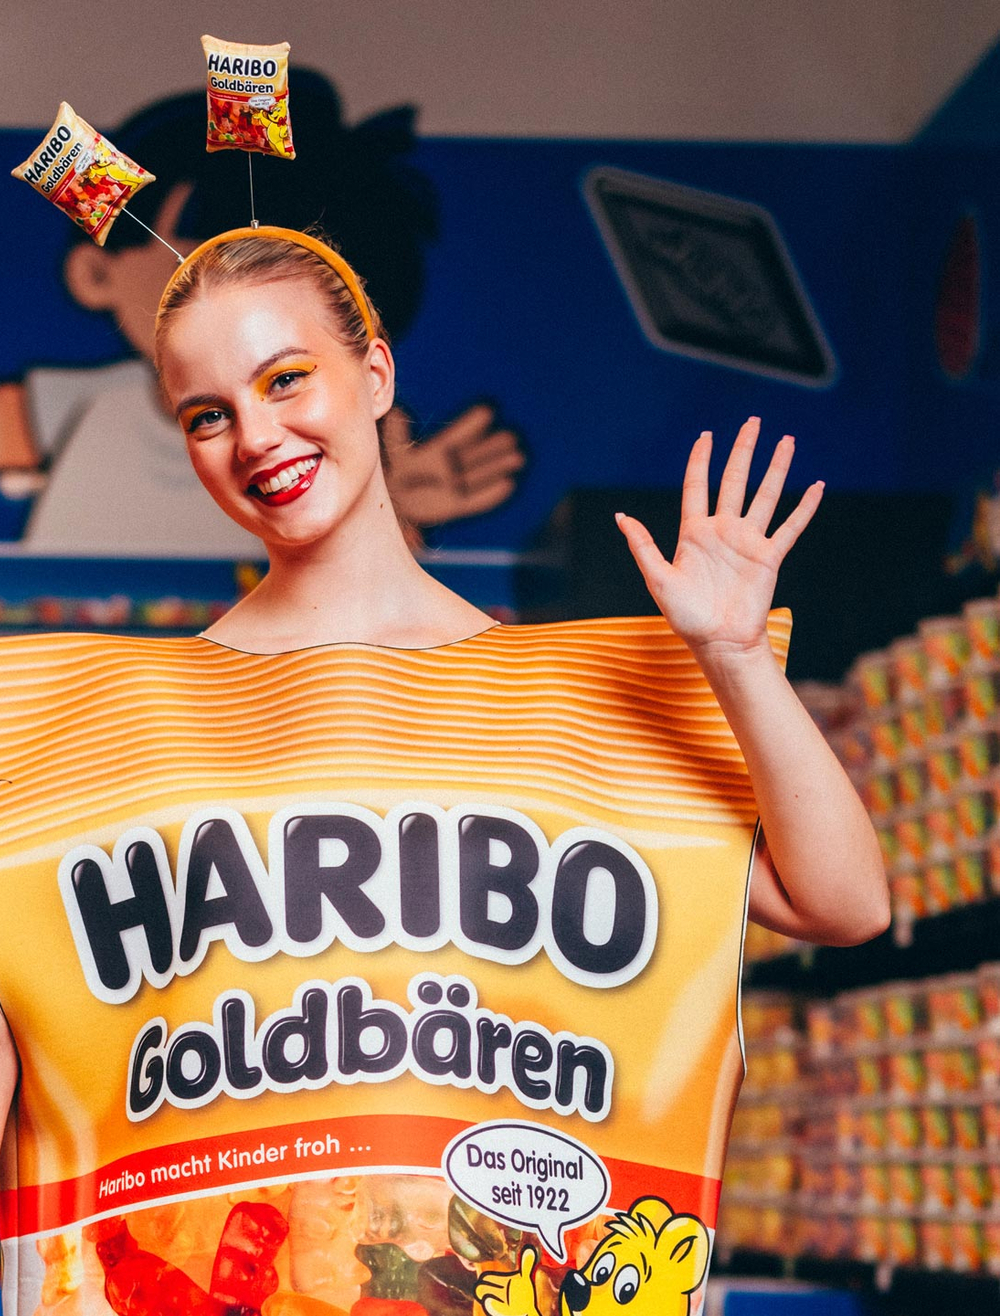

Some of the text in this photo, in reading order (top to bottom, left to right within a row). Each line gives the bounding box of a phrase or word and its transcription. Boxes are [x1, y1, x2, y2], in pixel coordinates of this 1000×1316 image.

[208, 53, 277, 77] HARIBO
[210, 76, 274, 93] Goldbären
[23, 125, 71, 185] HARIBO
[41, 142, 84, 193] Goldbären
[69, 809, 650, 993] HARIBO
[126, 980, 607, 1114] Goldbären
[99, 1170, 146, 1199] Haribo
[151, 1154, 212, 1183] macht
[218, 1143, 288, 1171] Kinder
[294, 1134, 340, 1158] froh
[466, 1143, 584, 1182] Das Original
[491, 1181, 570, 1212] seit 1922
